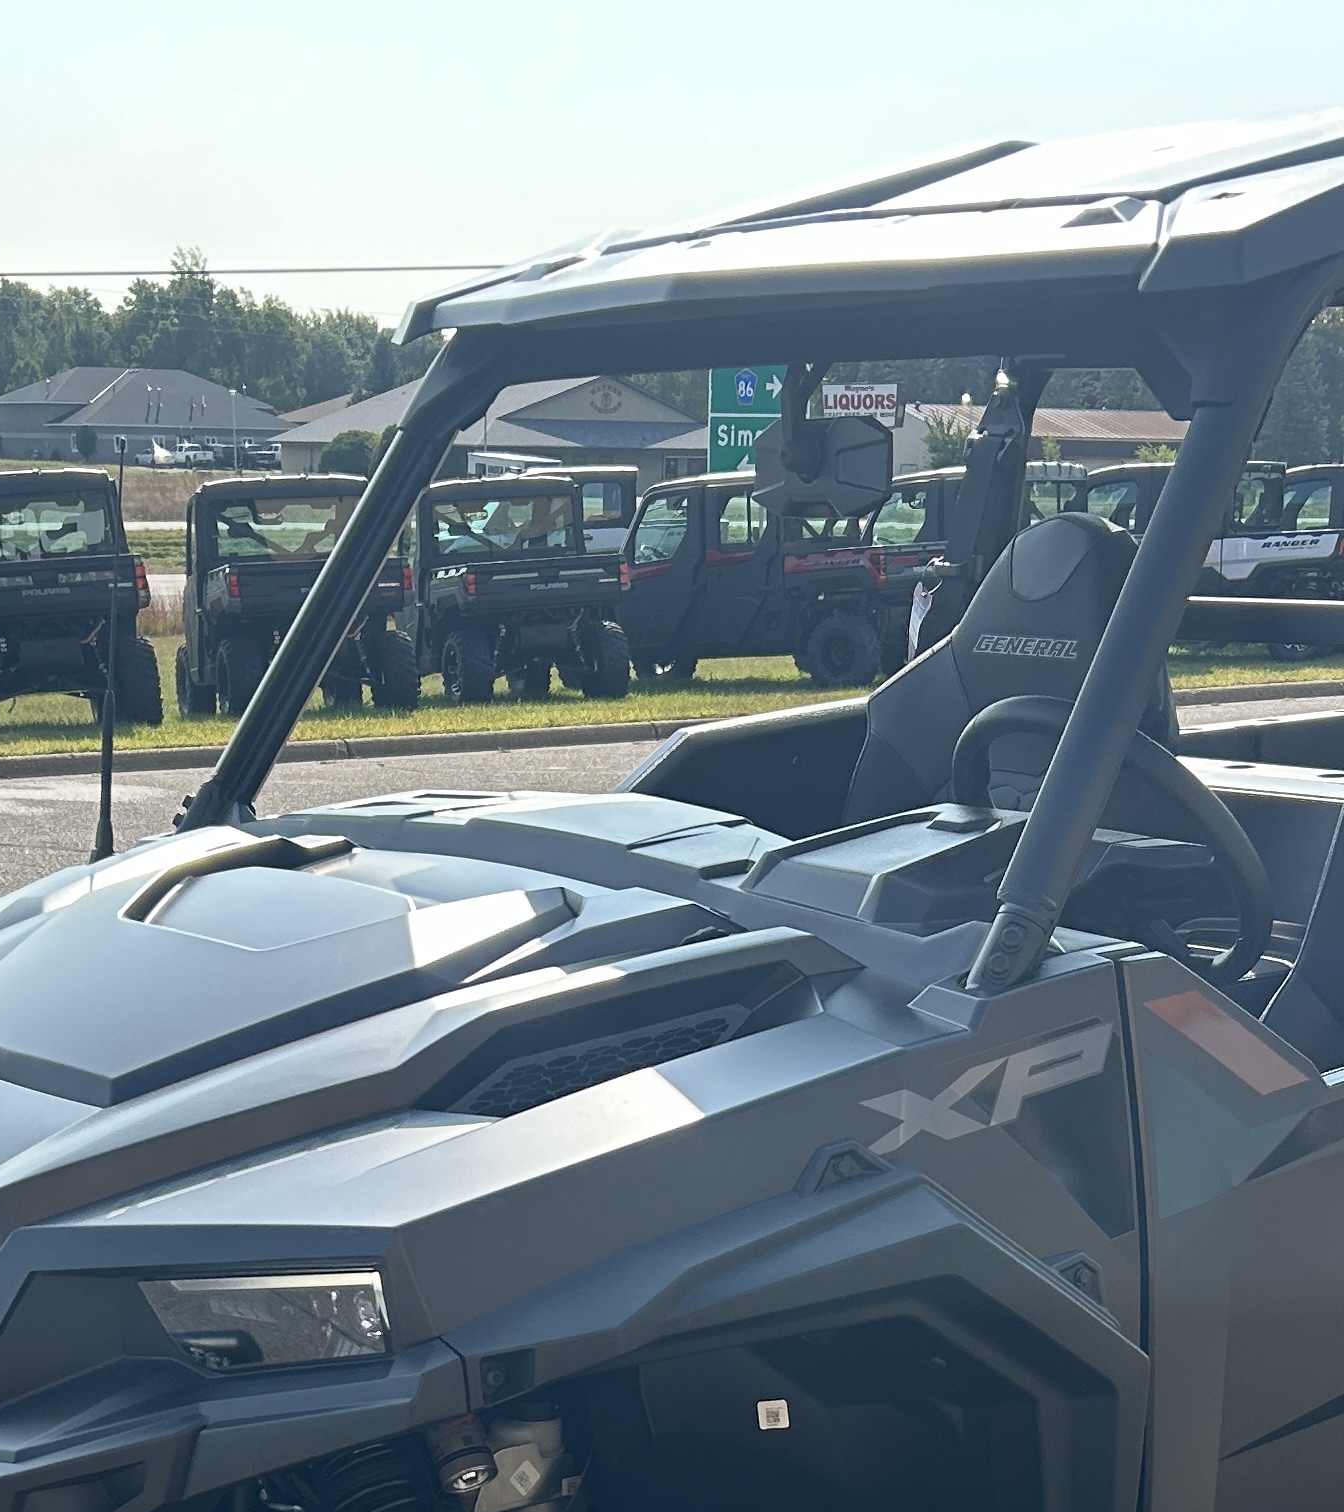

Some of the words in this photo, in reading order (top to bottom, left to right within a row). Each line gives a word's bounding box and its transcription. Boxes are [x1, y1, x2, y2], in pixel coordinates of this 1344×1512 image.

[737, 380, 754, 398] 86
[824, 393, 897, 411] LIQUORS
[1261, 538, 1321, 549] RANGER
[21, 587, 71, 597] POLARIS
[972, 633, 1079, 660] GENERAL
[858, 1018, 1113, 1156] XP
